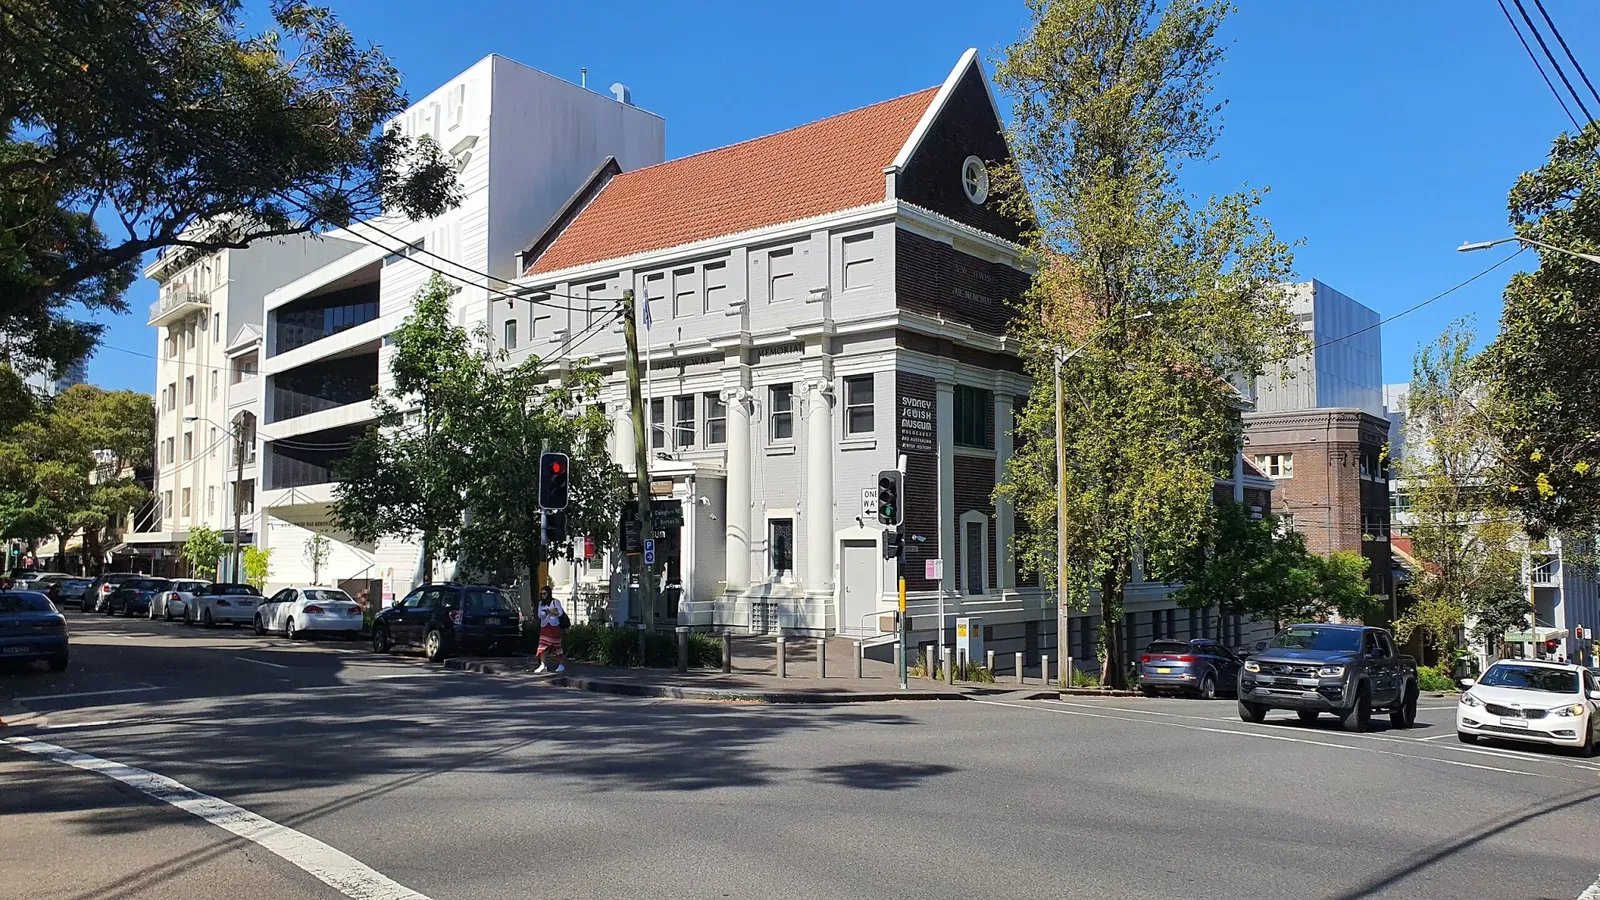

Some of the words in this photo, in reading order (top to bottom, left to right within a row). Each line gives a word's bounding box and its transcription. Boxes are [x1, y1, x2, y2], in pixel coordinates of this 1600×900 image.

[657, 360, 686, 370] JEWISH
[691, 356, 711, 365] WAR
[902, 396, 931, 409] SYDNEY
[902, 407, 931, 420] JEWISH
[902, 418, 931, 431] MUSEUM
[864, 490, 877, 498] ONE
[646, 541, 651, 549] P
